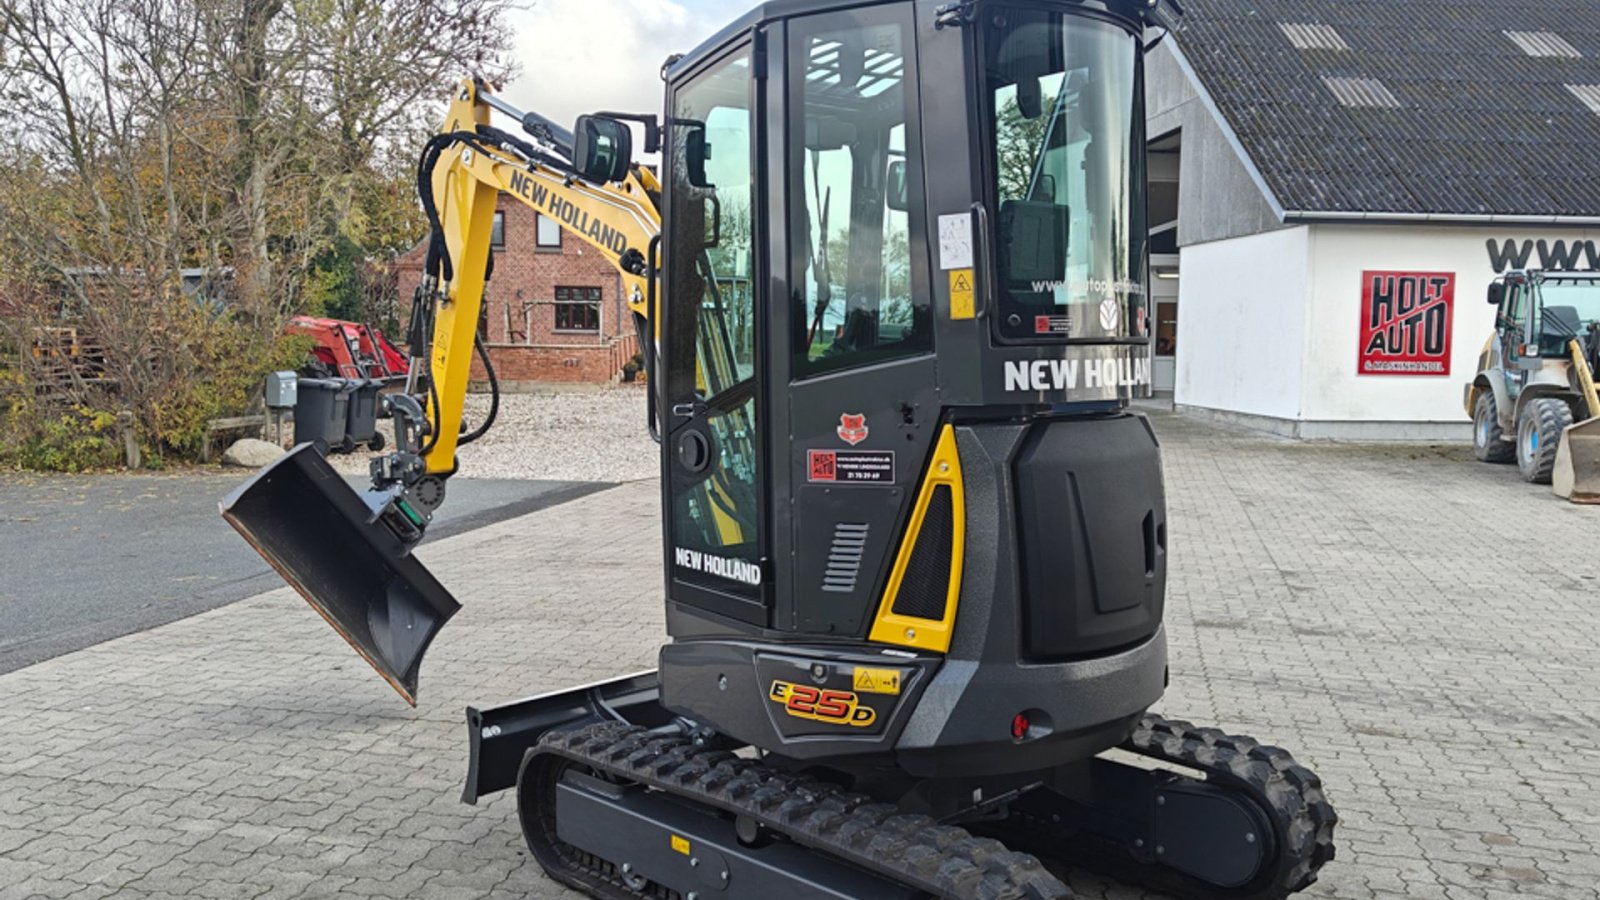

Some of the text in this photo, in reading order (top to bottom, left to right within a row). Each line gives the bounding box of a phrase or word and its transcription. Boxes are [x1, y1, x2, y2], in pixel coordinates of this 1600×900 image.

[510, 169, 628, 256] NEW HOLLAND
[1365, 301, 1447, 356] AUTO
[1371, 275, 1448, 330] HOLT
[1004, 359, 1079, 391] NEW
[675, 547, 761, 585] NEW HOLLAND
